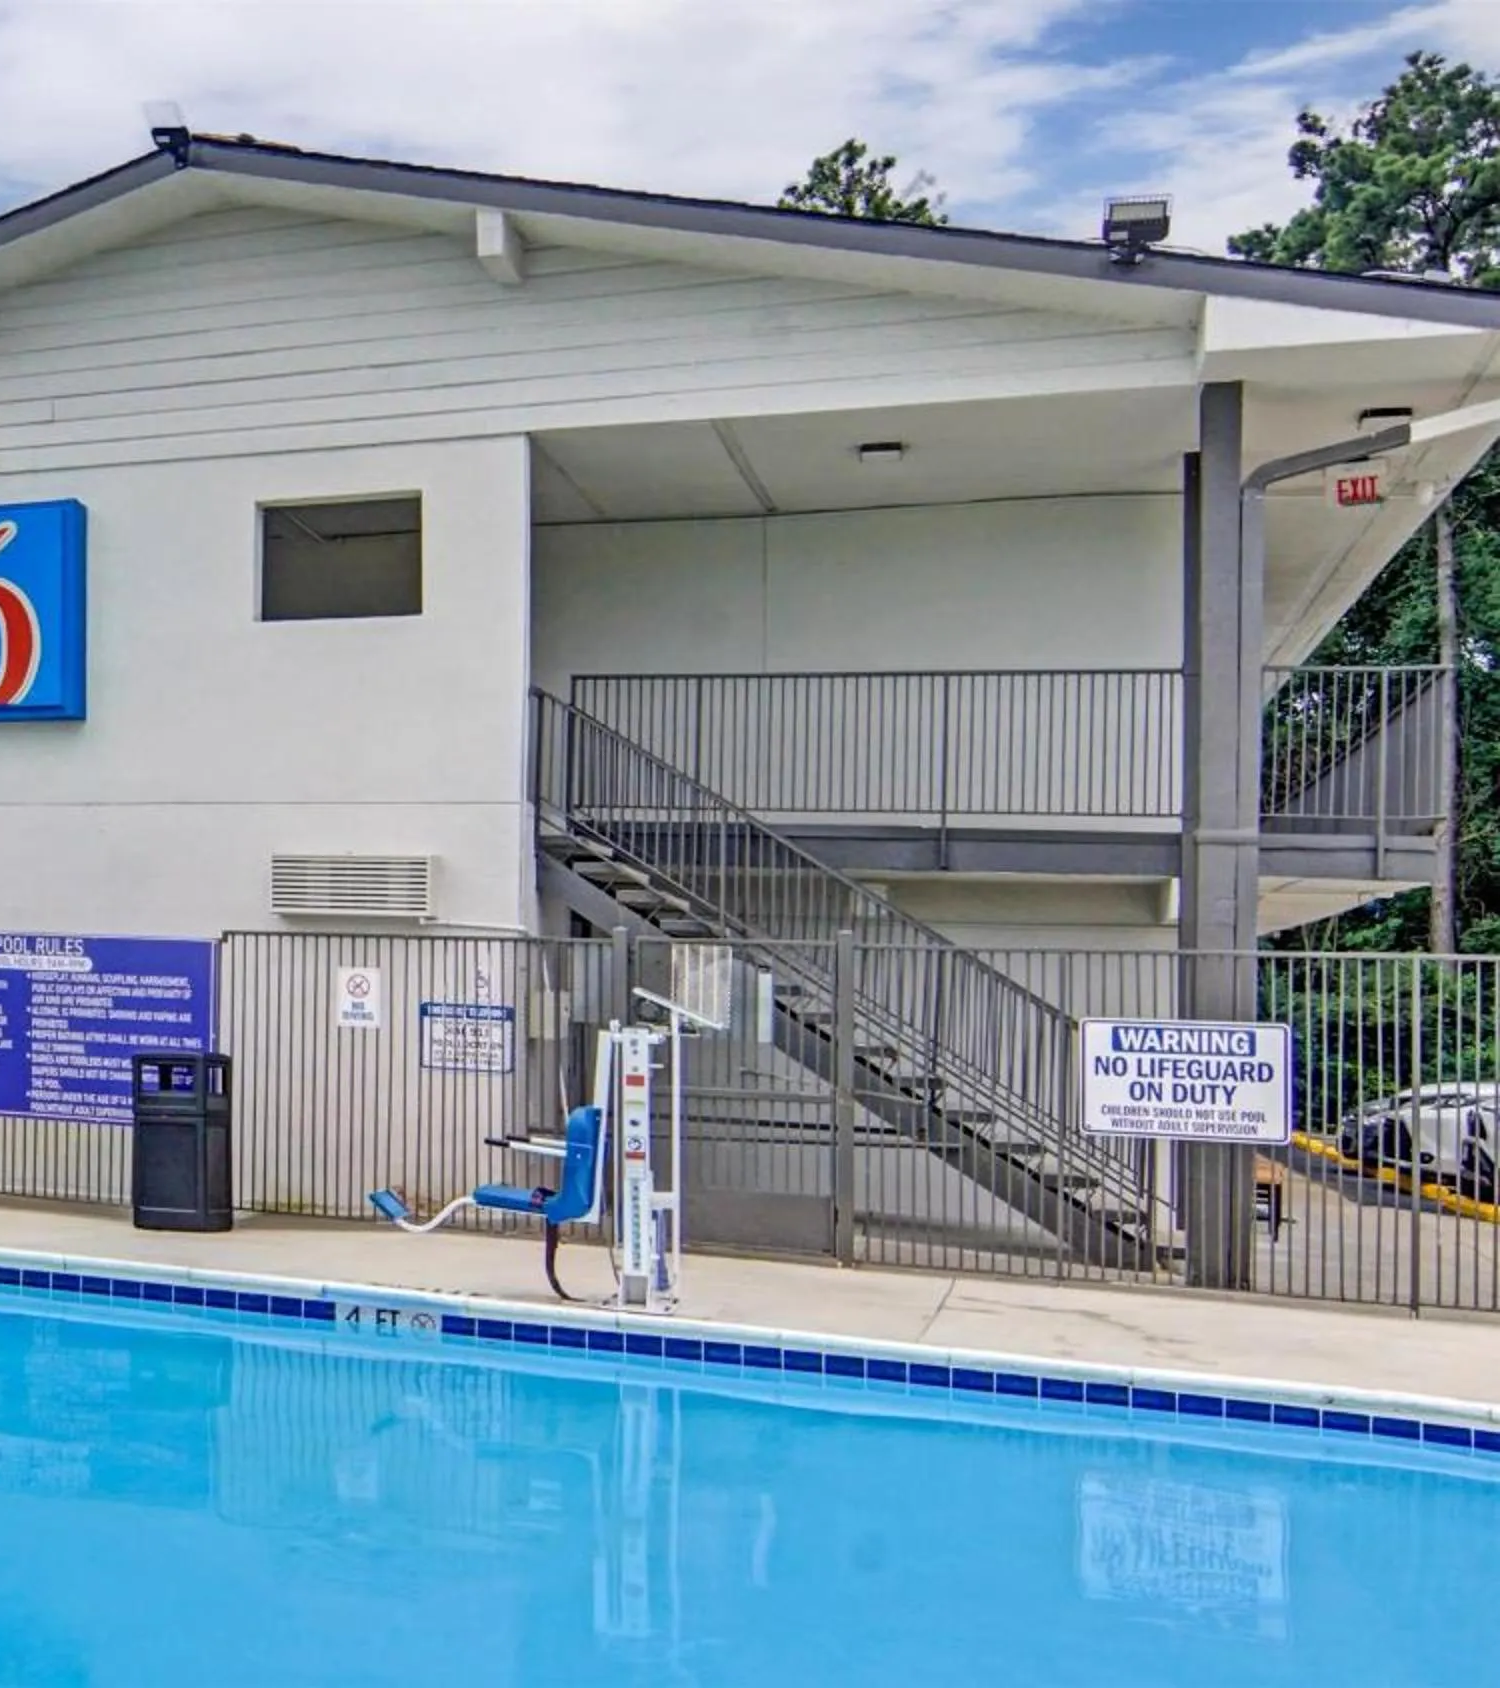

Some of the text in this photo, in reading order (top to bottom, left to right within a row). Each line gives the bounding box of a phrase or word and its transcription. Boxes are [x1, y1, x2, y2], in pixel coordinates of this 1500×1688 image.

[1336, 475, 1378, 505] EXIT
[35, 937, 85, 956] RULES
[1117, 1027, 1251, 1055] WARNING
[1094, 1056, 1274, 1083] NO LIFEGUARD
[1128, 1081, 1238, 1106] ON DUTY
[1101, 1103, 1267, 1123] CHILDREN SHOULD NOT USE POOL
[1110, 1117, 1258, 1135] WITHOUT ADULT SUPERVISION
[375, 1308, 401, 1327] FT
